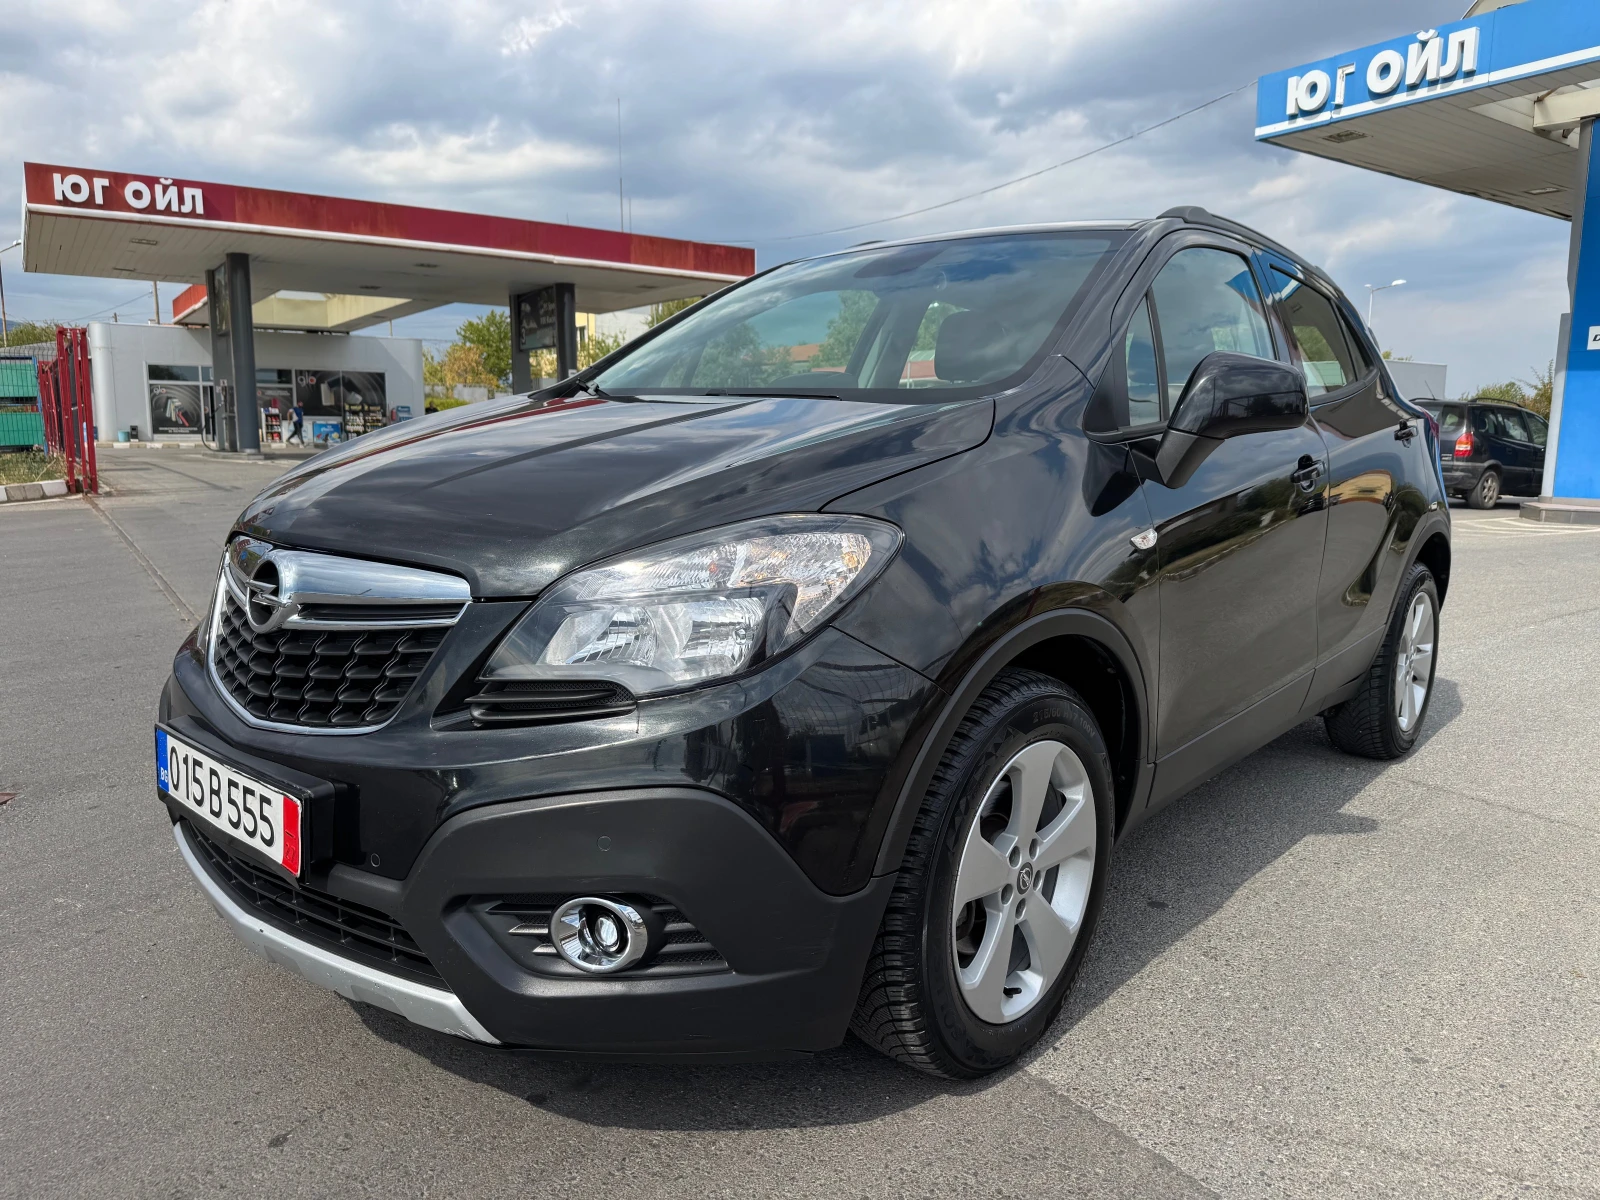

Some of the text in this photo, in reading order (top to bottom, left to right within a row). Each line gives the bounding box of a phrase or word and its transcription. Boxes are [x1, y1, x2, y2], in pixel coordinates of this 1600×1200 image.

[1285, 27, 1480, 116] ЮГ ОЙЛ
[52, 172, 204, 215] ЮГ ОЙЛ
[153, 384, 167, 395] glo
[297, 371, 316, 387] glo
